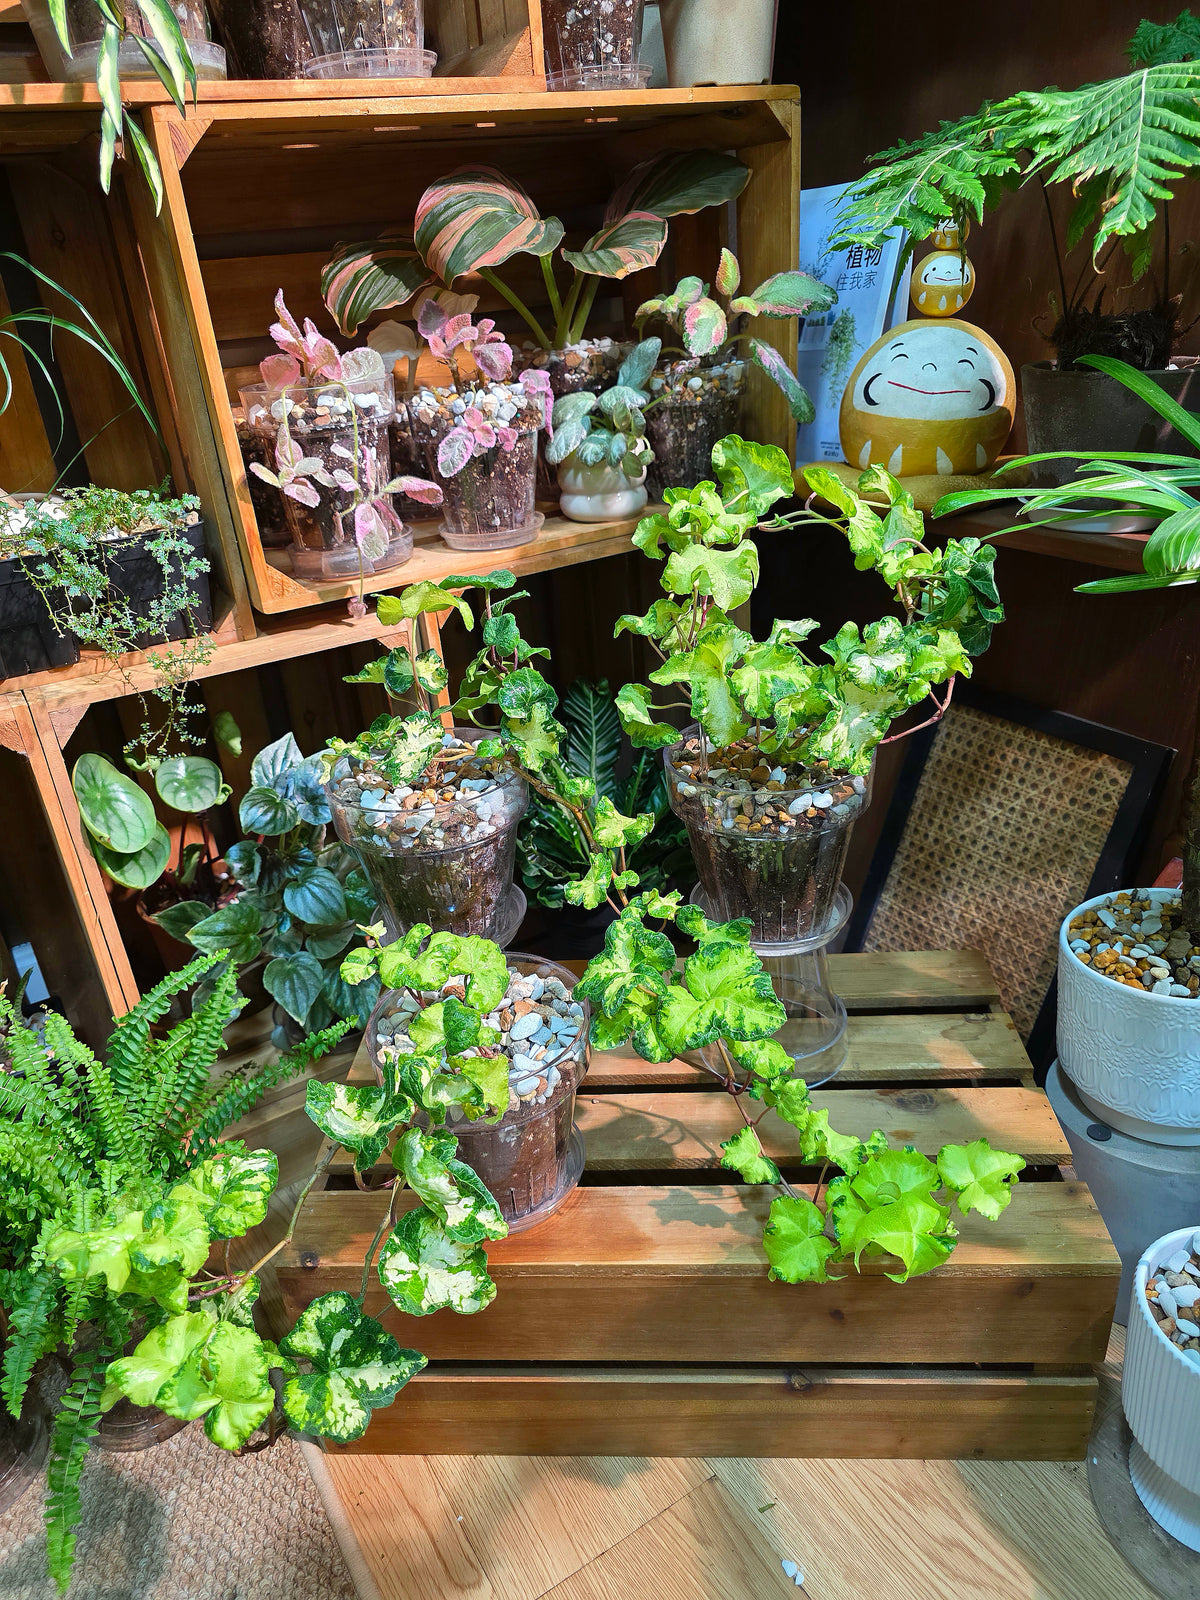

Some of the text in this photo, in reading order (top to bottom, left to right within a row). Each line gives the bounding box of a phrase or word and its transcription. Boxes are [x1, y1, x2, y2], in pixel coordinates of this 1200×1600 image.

[846, 244, 883, 270] 植物
[836, 270, 877, 291] 住我家
